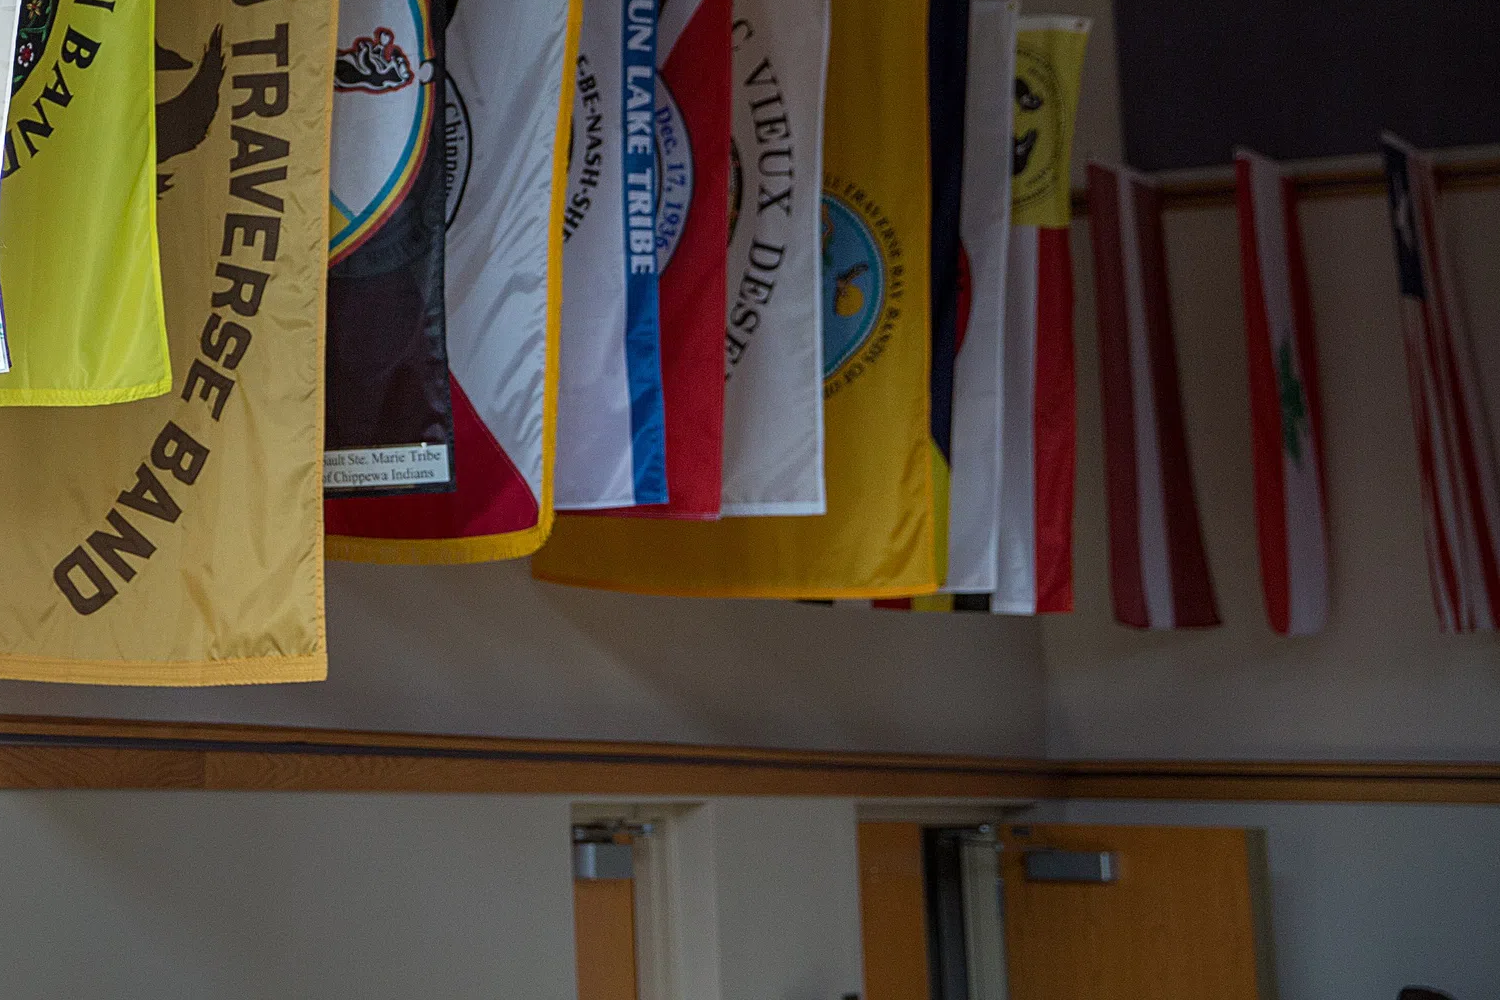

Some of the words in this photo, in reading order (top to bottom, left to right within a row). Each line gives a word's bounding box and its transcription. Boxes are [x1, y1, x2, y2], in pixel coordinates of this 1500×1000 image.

[626, 67, 656, 157] LAKE
[656, 106, 678, 155] Dec.
[743, 58, 792, 218] VIEUX
[181, 23, 290, 422] TRAVERSE
[627, 167, 657, 278] TRIBE
[656, 202, 685, 250] 1936
[725, 239, 785, 382] DESE
[334, 471, 388, 485] Chippewa
[391, 468, 435, 480] Indians
[348, 454, 368, 466] Ste.
[372, 451, 405, 464] Marie
[409, 450, 441, 462] Tribe
[52, 420, 211, 616] BAND
